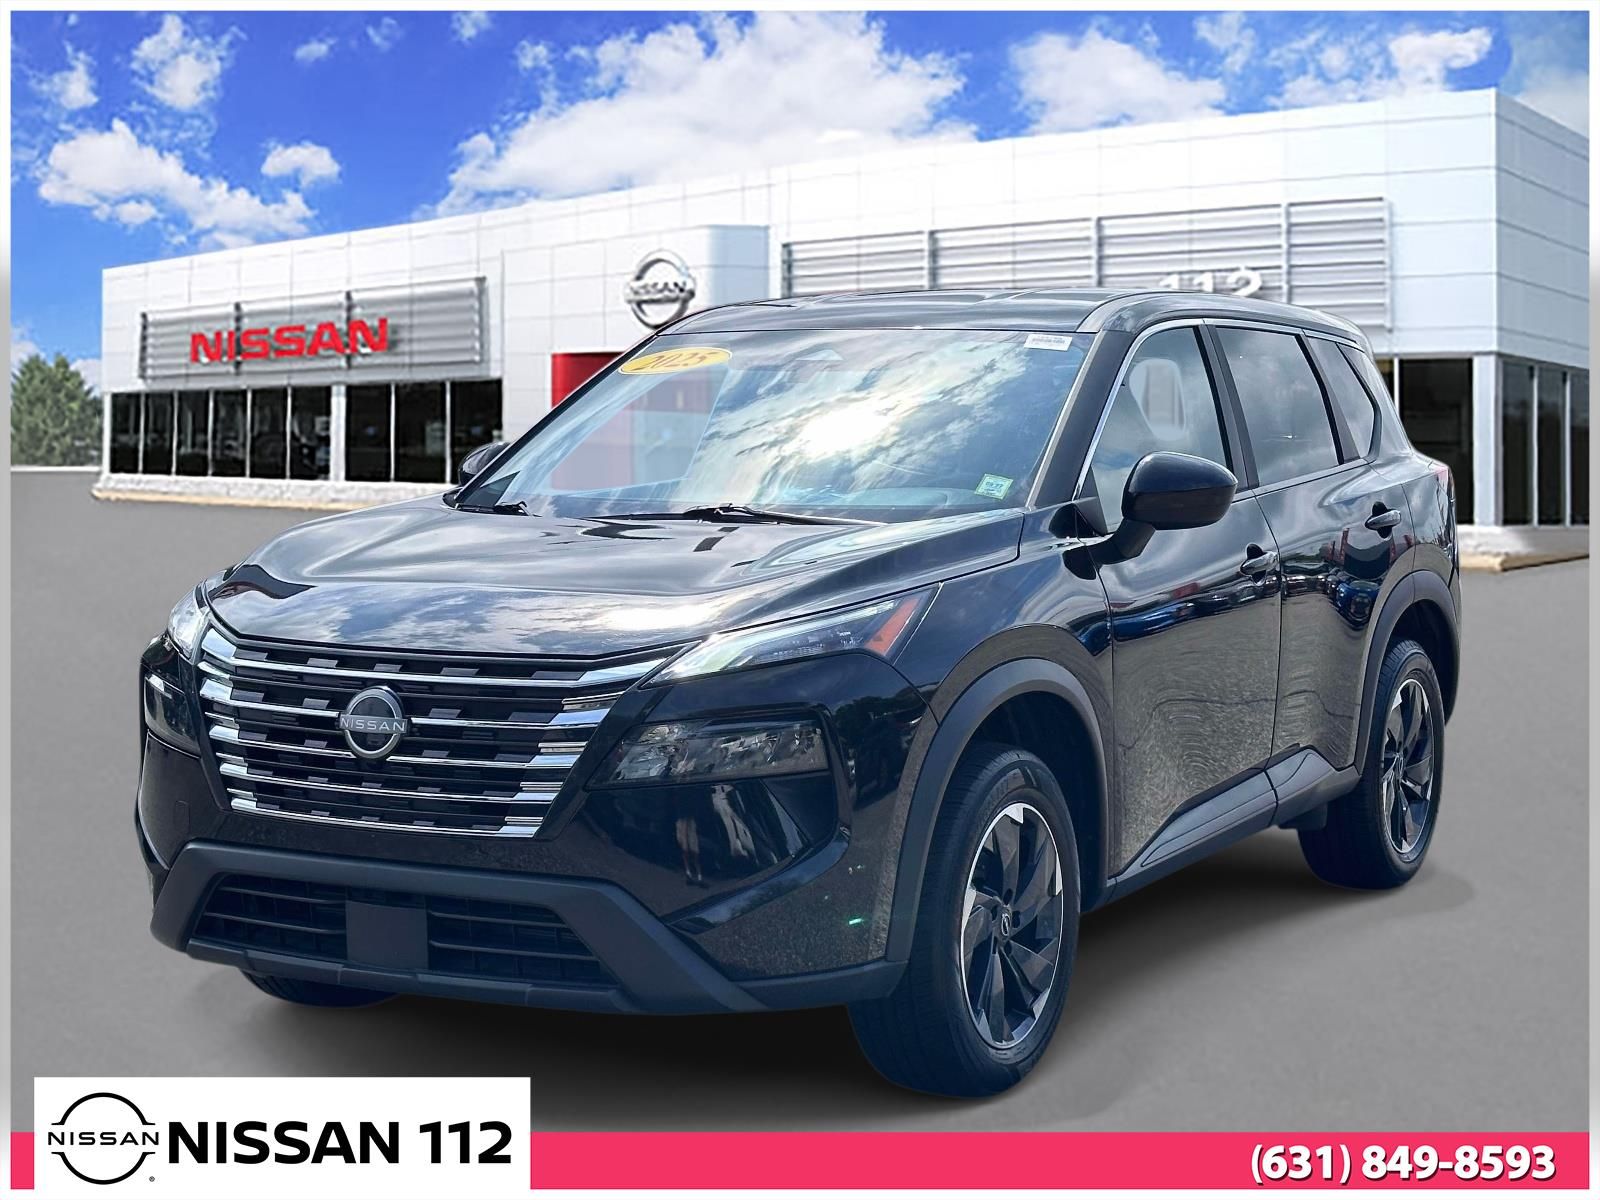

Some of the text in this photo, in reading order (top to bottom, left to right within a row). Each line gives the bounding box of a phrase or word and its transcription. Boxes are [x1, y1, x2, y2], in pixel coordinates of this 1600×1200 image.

[629, 280, 688, 296] NISSAN
[190, 317, 388, 364] NISSAN
[340, 717, 405, 732] NISSAN
